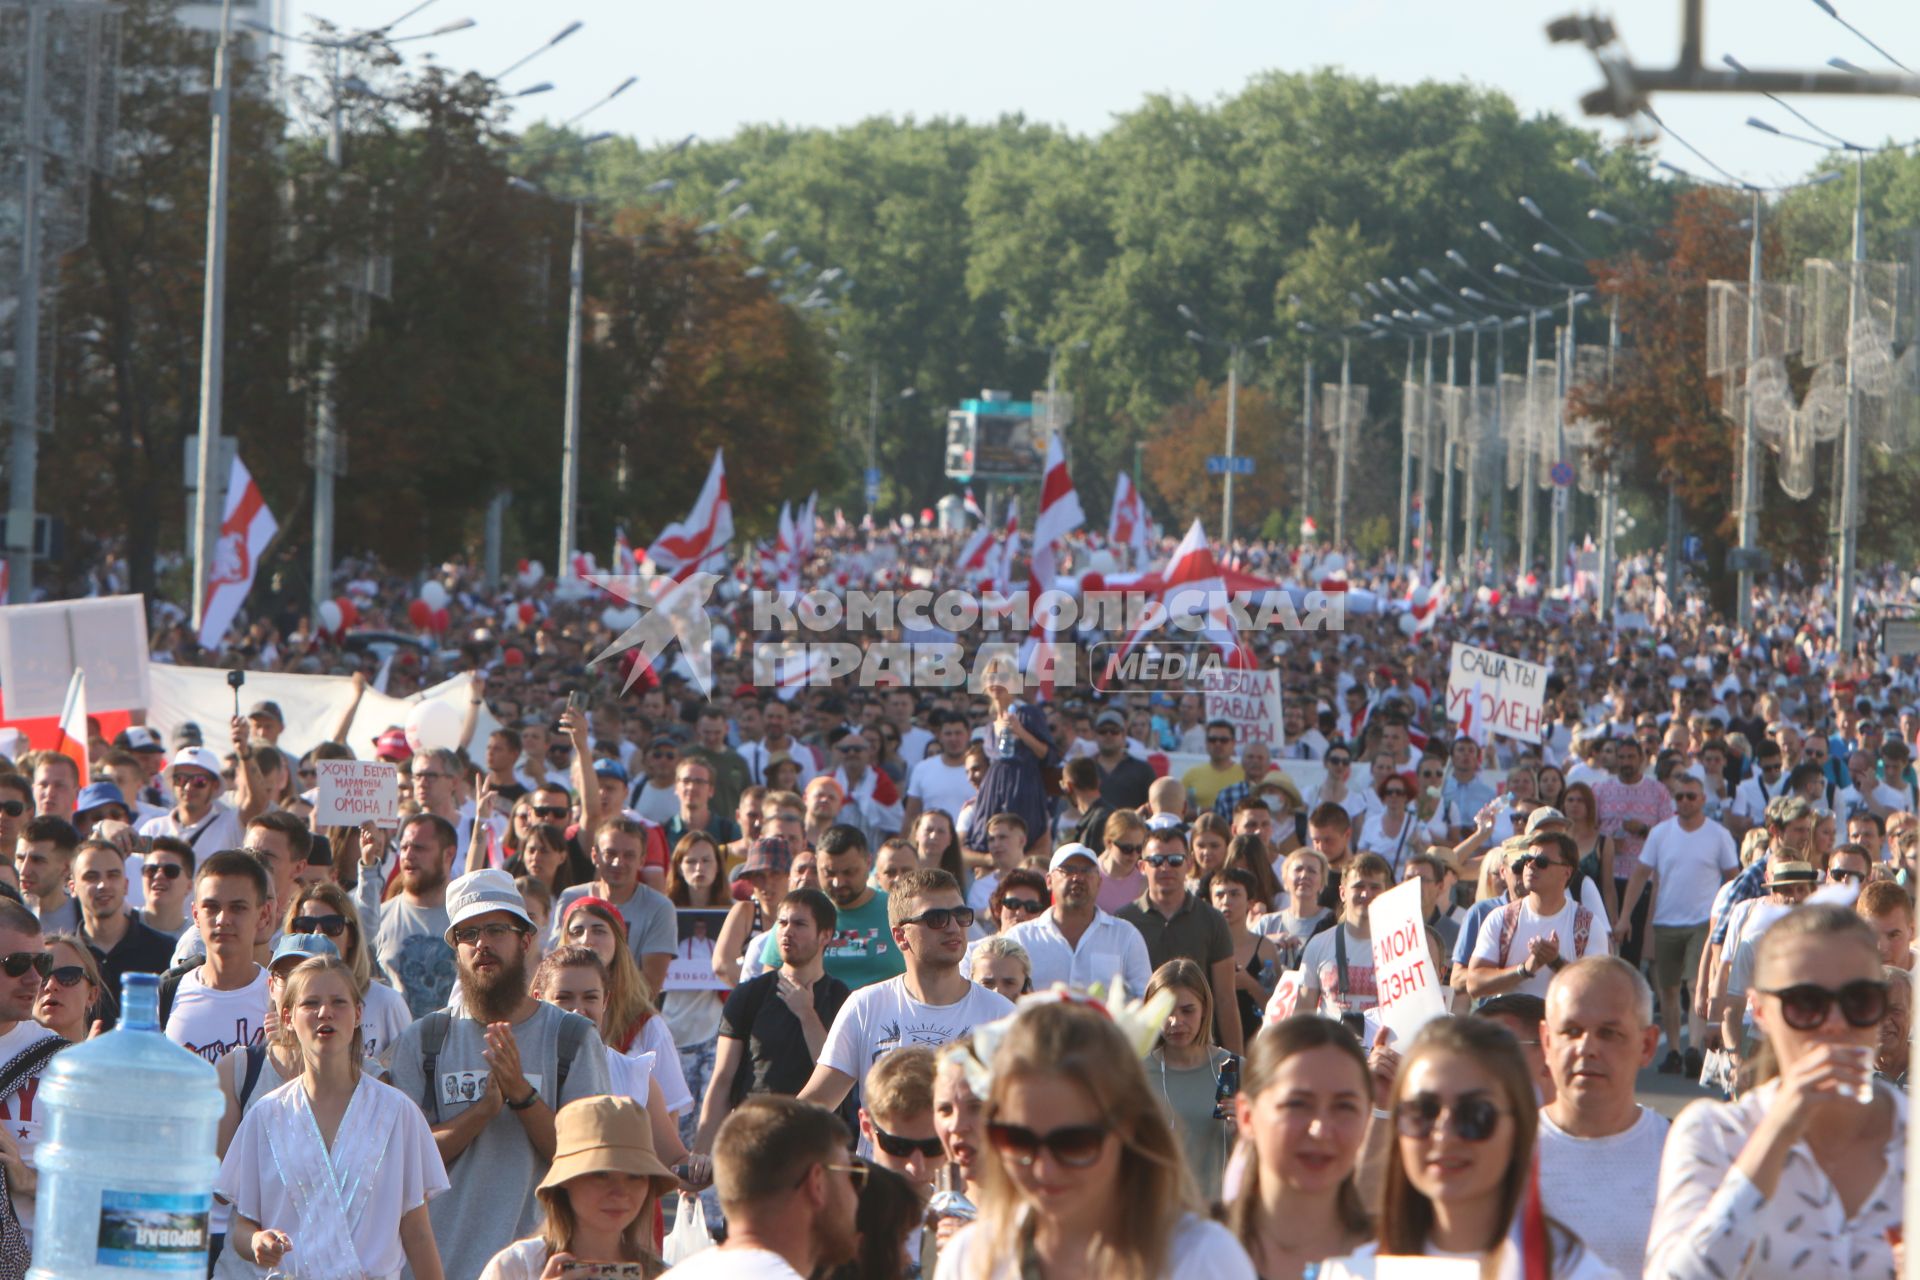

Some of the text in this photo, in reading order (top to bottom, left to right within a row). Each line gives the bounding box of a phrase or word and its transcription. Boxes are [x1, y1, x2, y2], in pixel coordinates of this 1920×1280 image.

[1514, 662, 1537, 689] ТЫ
[321, 763, 355, 776] ХОЧУ
[334, 797, 380, 814] ОМОНА
[1381, 919, 1419, 964] МОЙ
[1381, 960, 1427, 1009] ДЭНТ
